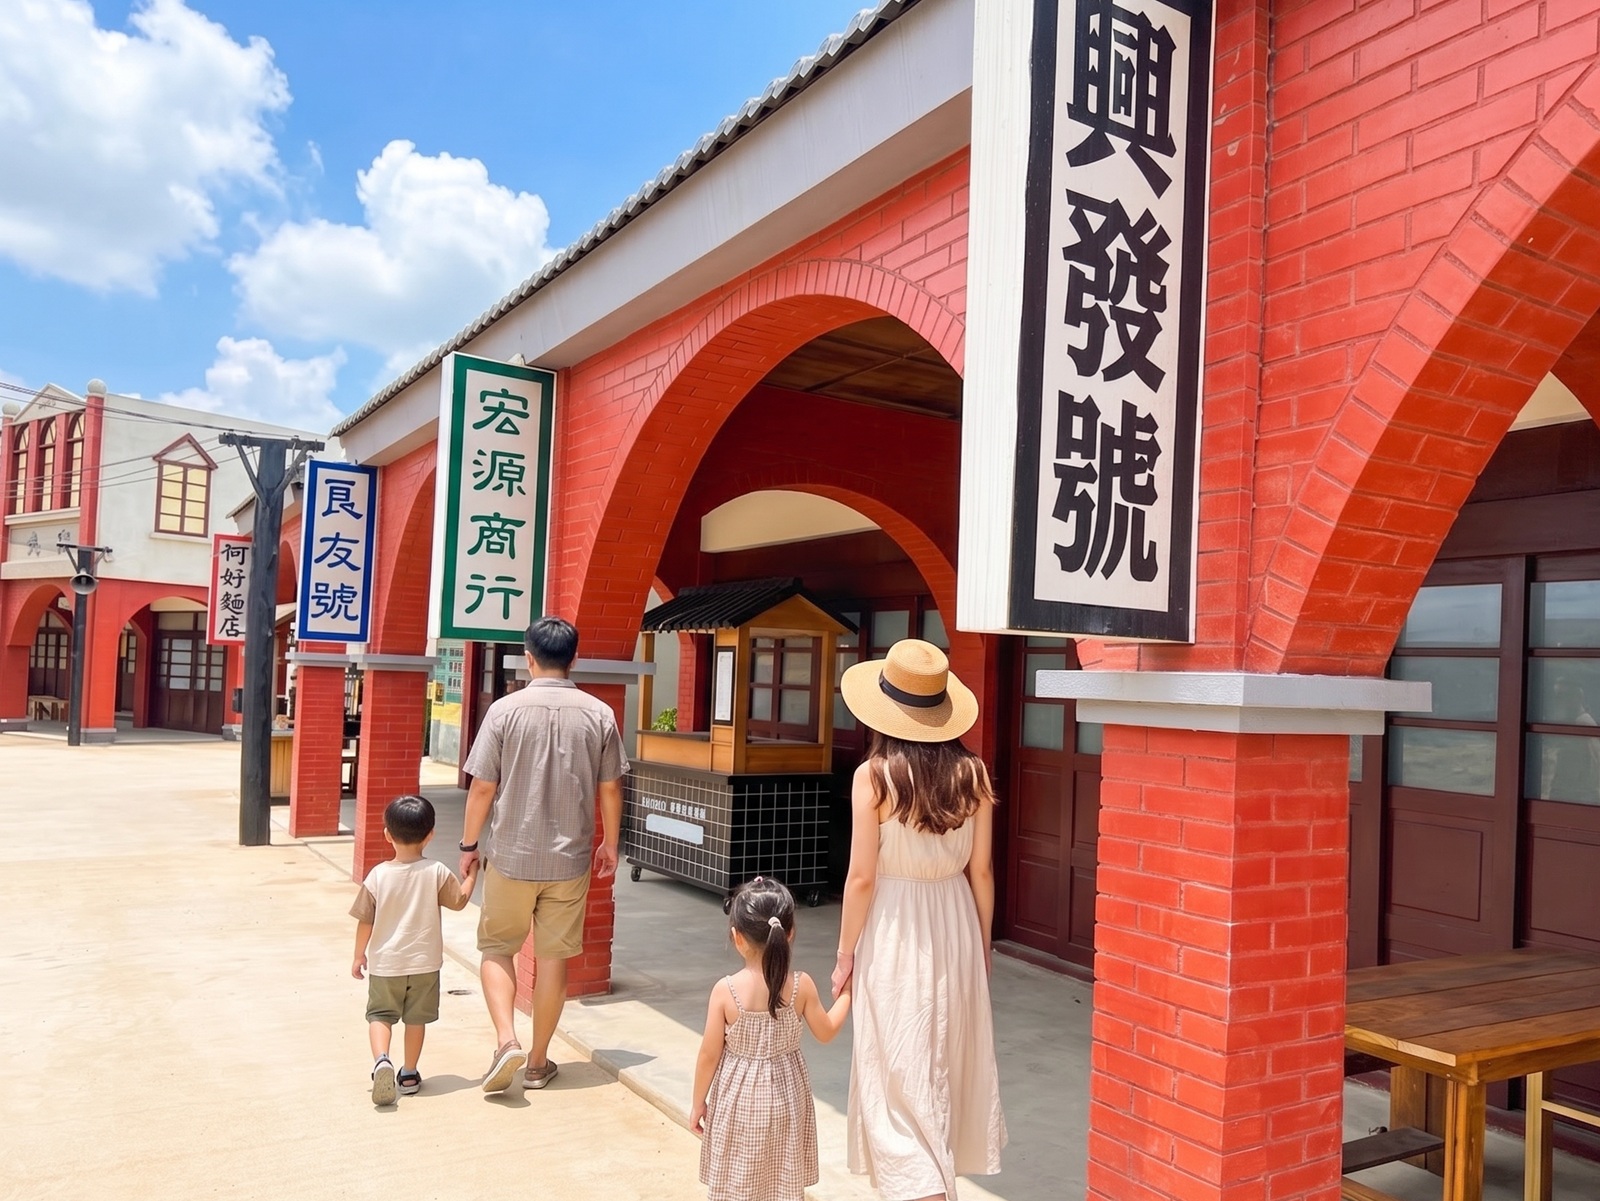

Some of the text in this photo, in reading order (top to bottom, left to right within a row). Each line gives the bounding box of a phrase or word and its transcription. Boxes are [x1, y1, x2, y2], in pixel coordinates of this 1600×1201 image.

[1052, 0, 1178, 582] 興發號
[464, 388, 529, 620] 宏源商行
